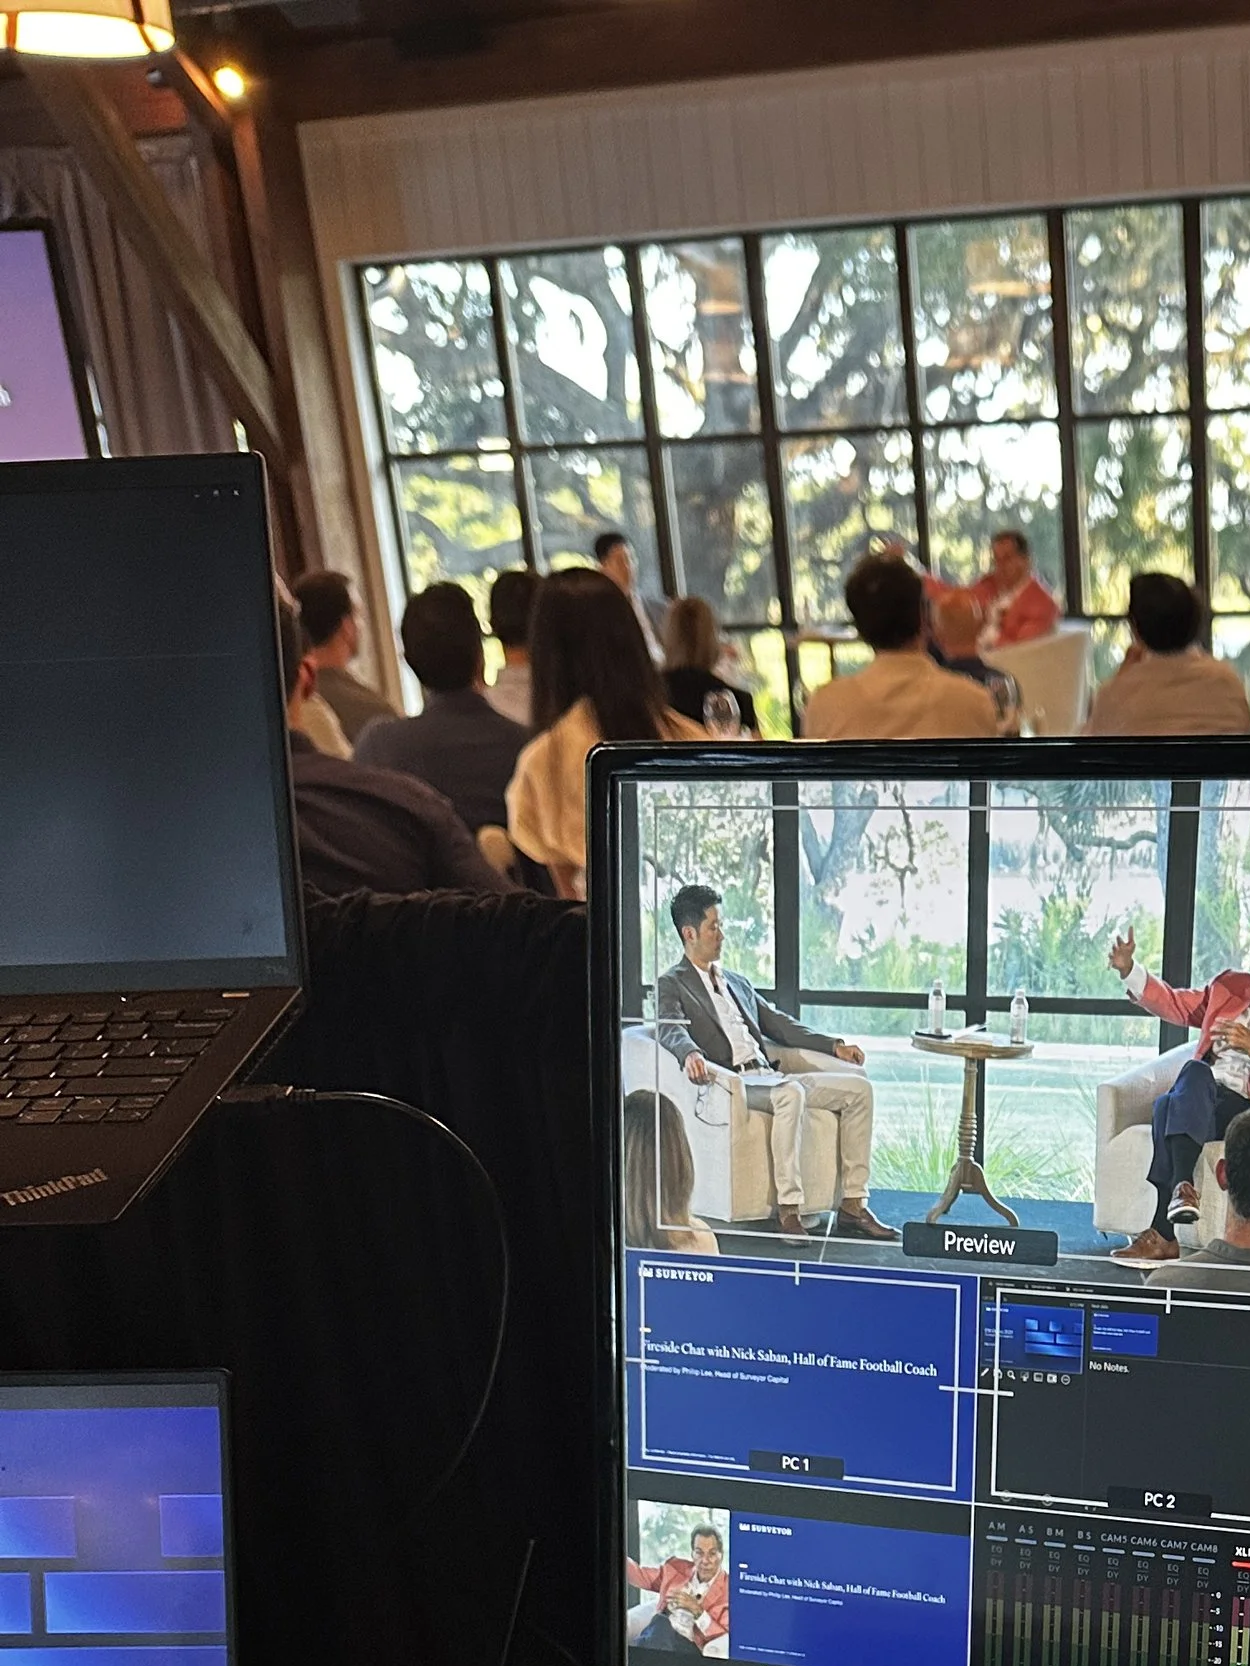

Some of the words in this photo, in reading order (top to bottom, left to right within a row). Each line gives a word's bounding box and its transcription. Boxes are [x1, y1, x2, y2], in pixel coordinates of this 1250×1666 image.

[0, 1168, 108, 1206] ThinkPad
[944, 1231, 1015, 1255] Preview
[656, 1268, 714, 1282] SURVEYOR
[681, 1343, 705, 1356] Chat
[707, 1345, 729, 1359] with
[731, 1347, 755, 1361] Nick
[757, 1350, 791, 1365] Saban,
[793, 1352, 815, 1366] Hall
[817, 1354, 829, 1367] of
[829, 1357, 858, 1370] Fame
[860, 1359, 902, 1374] Football
[904, 1362, 937, 1377] Coach
[1089, 1361, 1102, 1372] No
[1104, 1362, 1129, 1373] Notes.
[781, 1456, 799, 1470] PC
[802, 1458, 810, 1471] 1
[1144, 1492, 1164, 1508] PC
[1166, 1495, 1176, 1509] 2
